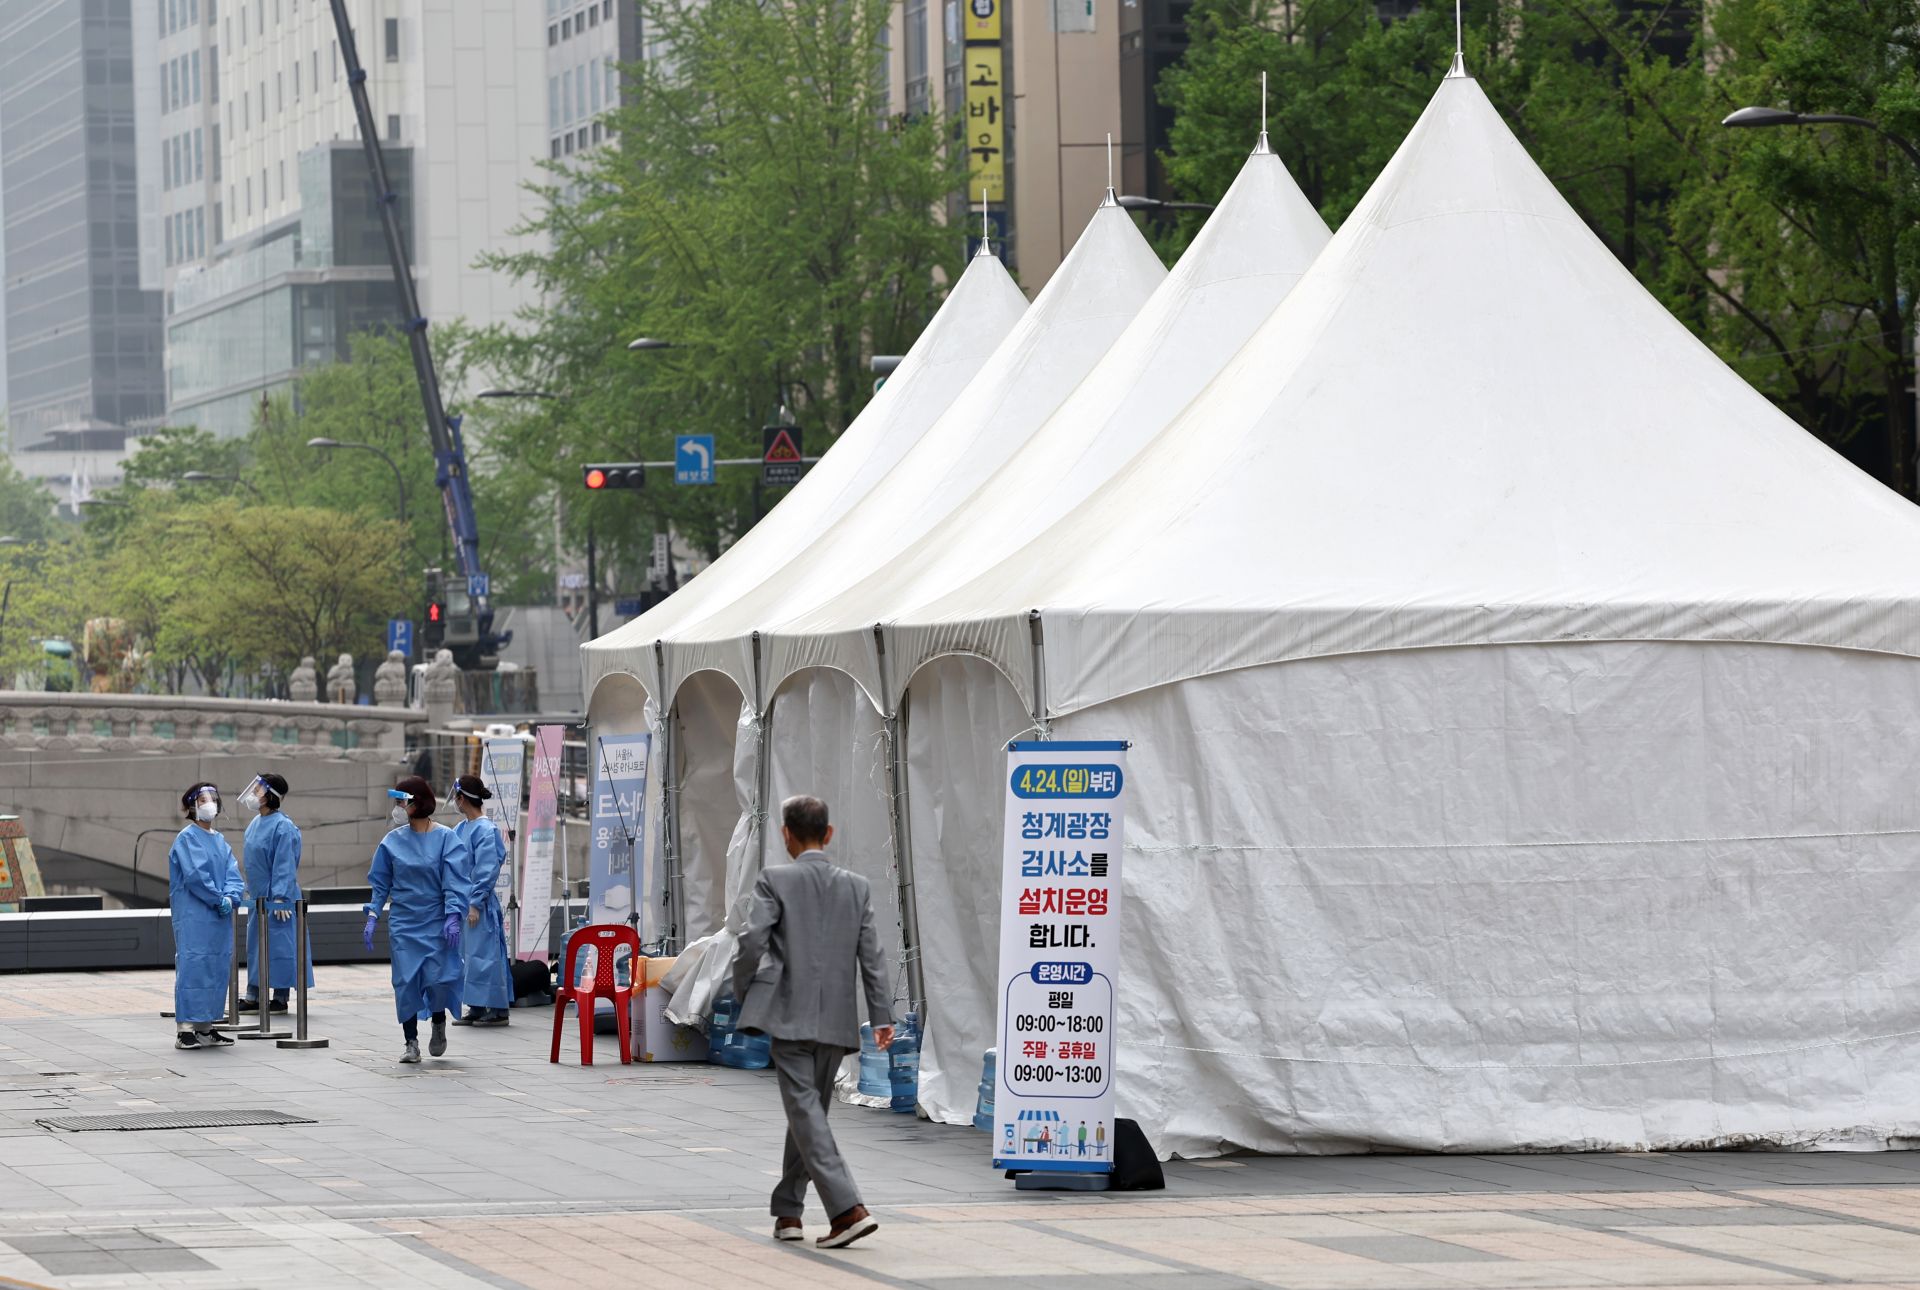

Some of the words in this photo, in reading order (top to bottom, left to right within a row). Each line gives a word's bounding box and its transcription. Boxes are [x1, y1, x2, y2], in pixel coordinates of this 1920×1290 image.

[970, 64, 999, 163] 고바우
[1022, 812, 1112, 840] 청계광장
[1022, 850, 1109, 877] 검사소를
[1018, 887, 1109, 916] 설치운영
[1029, 923, 1096, 948] 합니다.
[1038, 963, 1086, 981] 운영시간
[1048, 991, 1074, 1009] 평일
[1016, 1014, 1104, 1033] 09:00~18:00
[1022, 1040, 1048, 1059] 주말
[1058, 1041, 1096, 1060] 공휴일
[1014, 1064, 1102, 1083] 09:00~13:00
